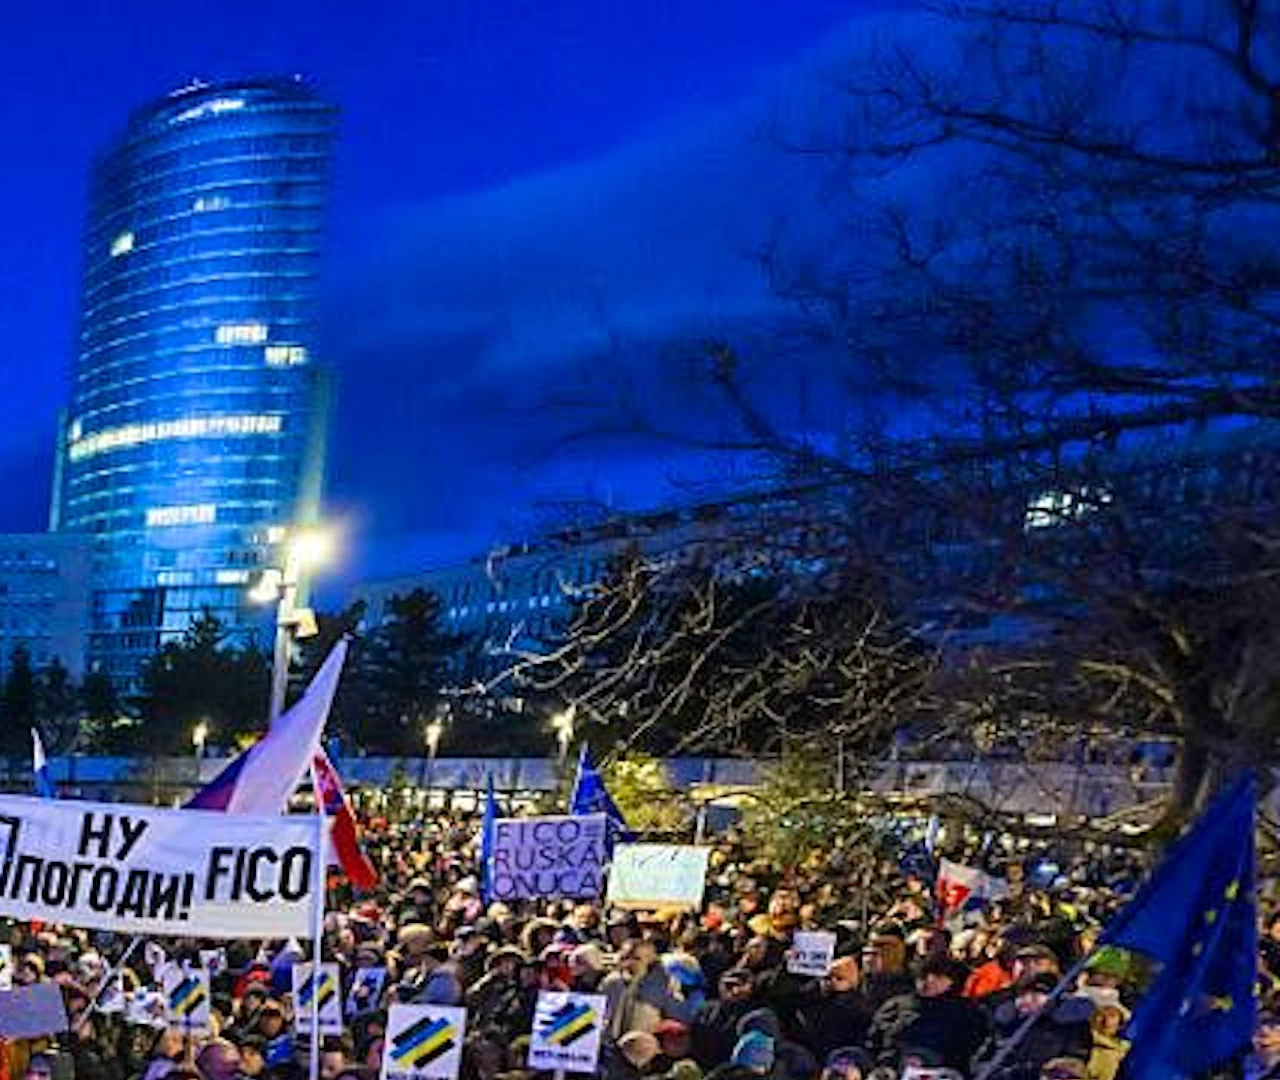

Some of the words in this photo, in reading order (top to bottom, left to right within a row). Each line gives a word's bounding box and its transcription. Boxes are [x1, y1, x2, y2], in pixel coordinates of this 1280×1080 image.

[78, 812, 148, 860] НУ
[11, 855, 194, 921] ПОГОДИ!
[206, 846, 311, 902] FICO
[495, 871, 598, 897] ONUCA
